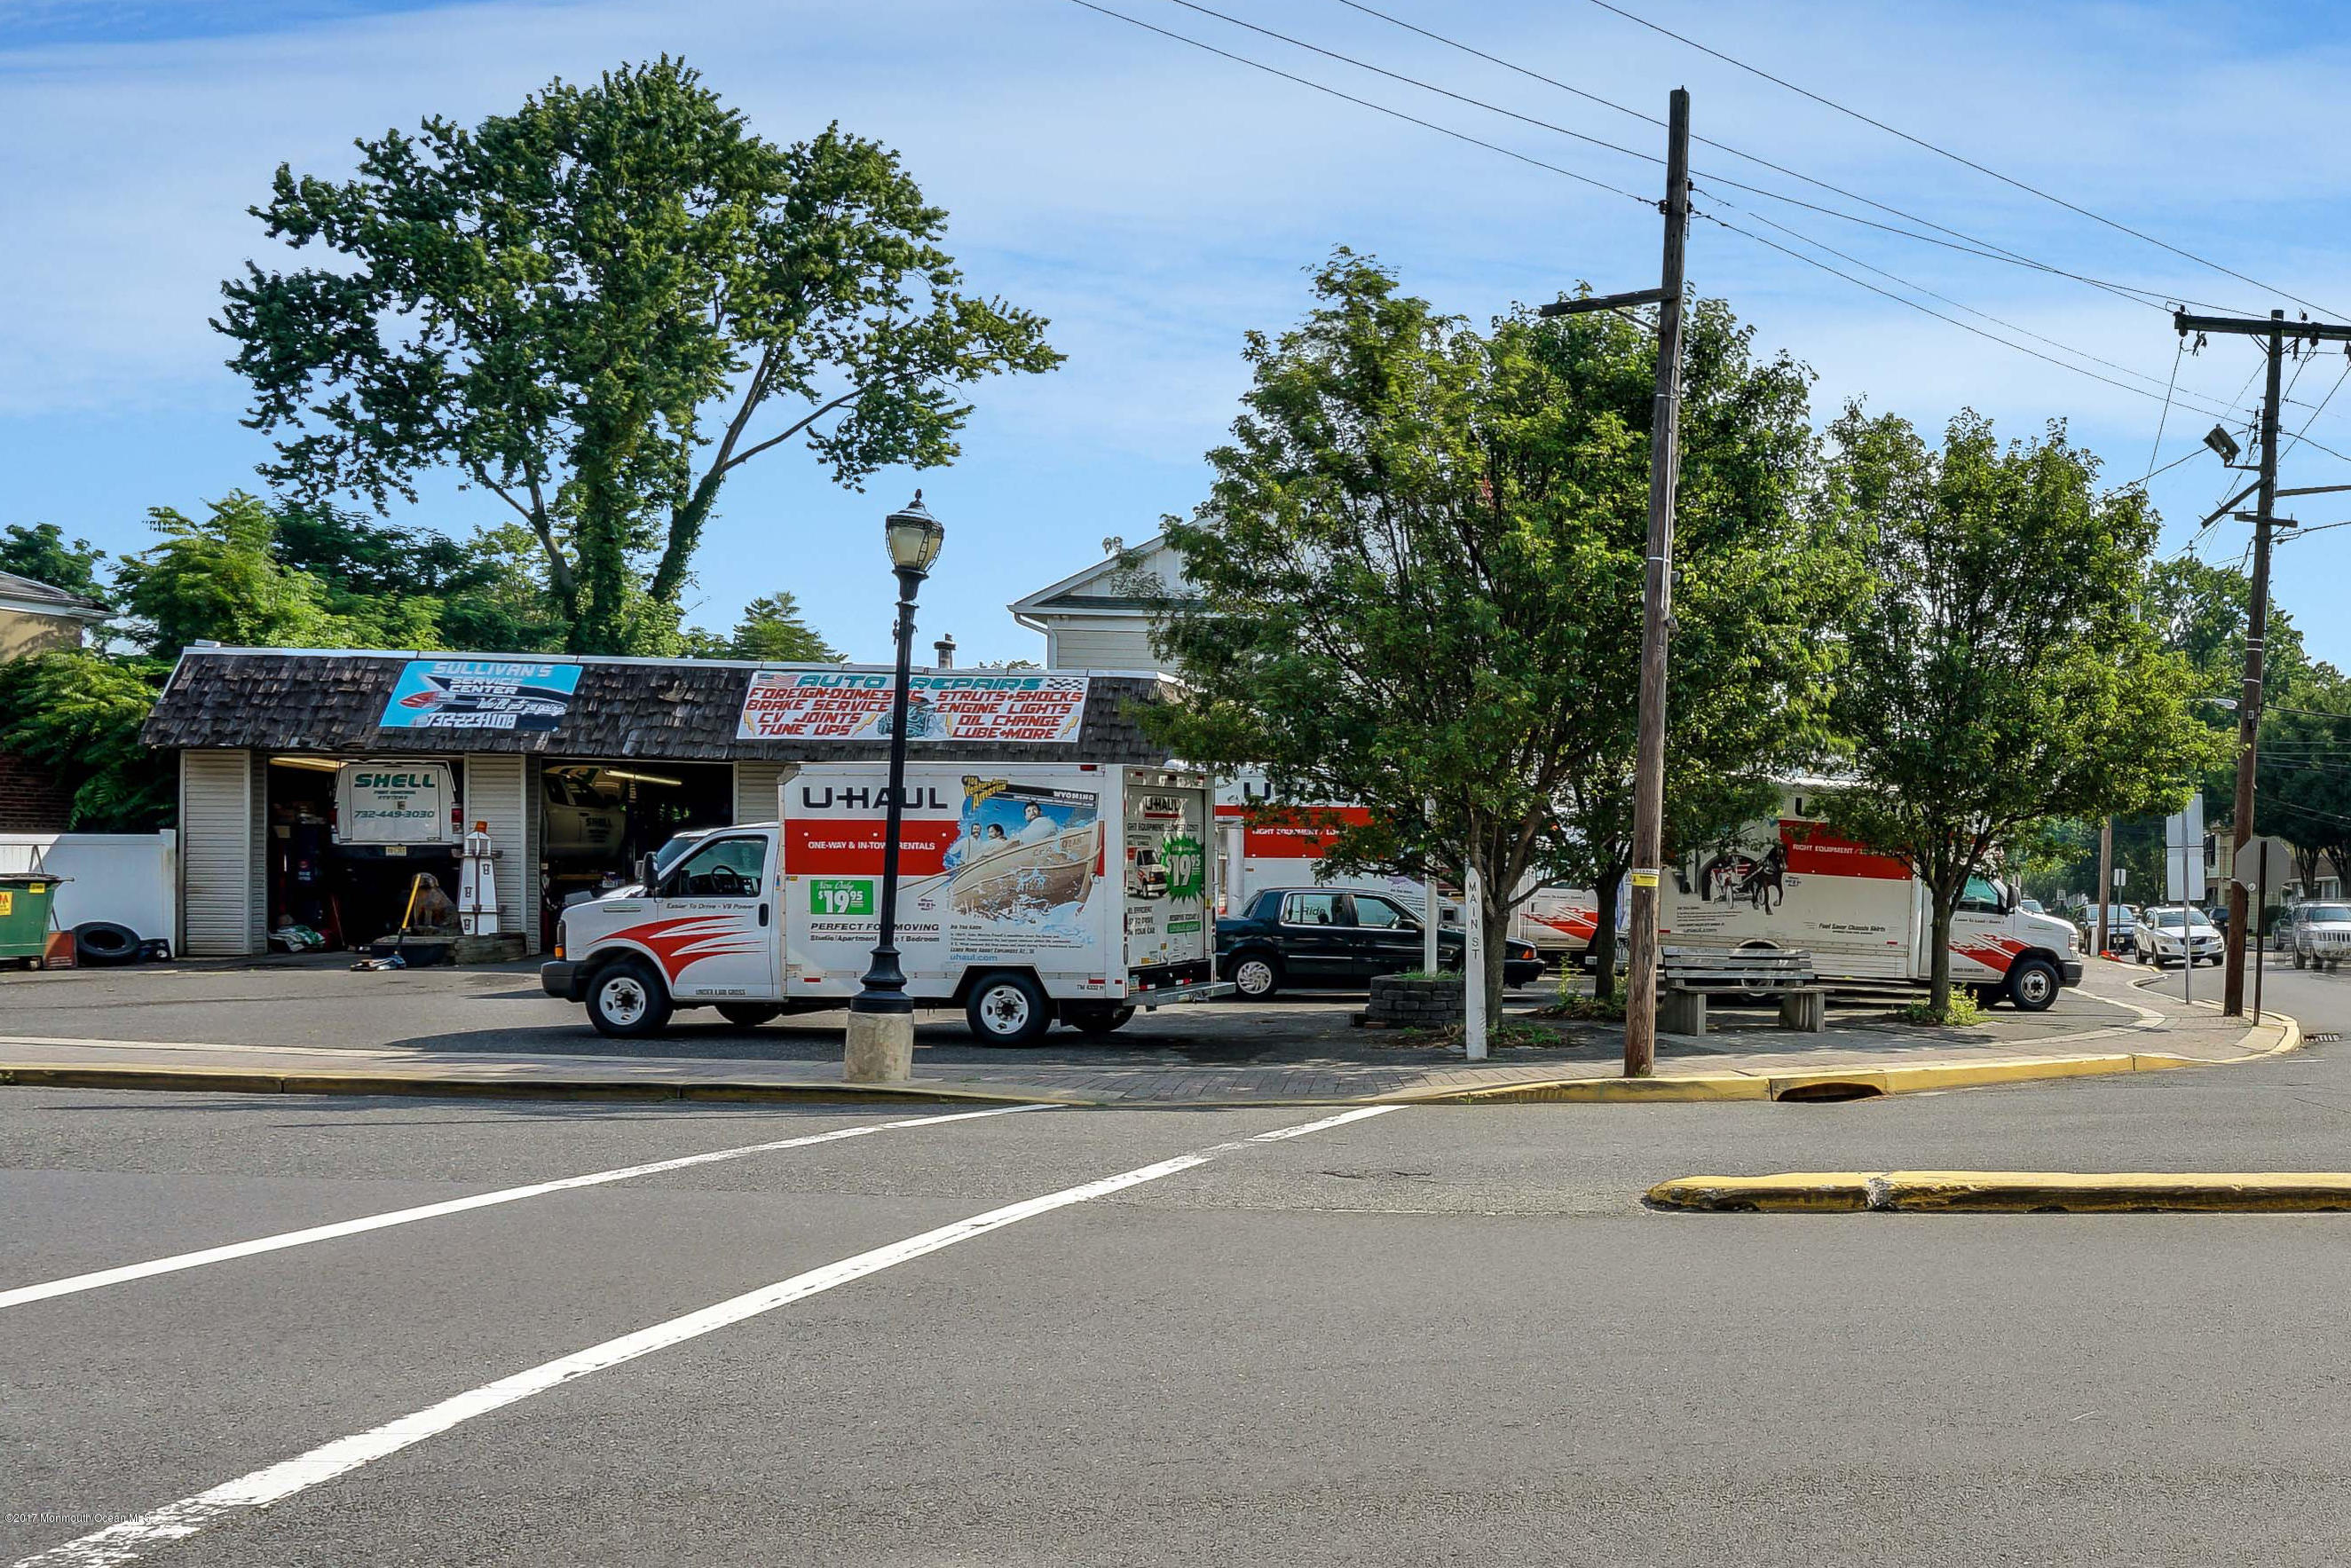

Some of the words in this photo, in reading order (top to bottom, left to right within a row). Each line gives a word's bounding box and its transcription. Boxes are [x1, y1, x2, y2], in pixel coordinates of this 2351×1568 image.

[432, 663, 553, 677] SULLIVAN'S
[450, 676, 524, 685] SERVICE
[796, 674, 887, 688] AUTO
[909, 677, 1044, 690] REPAIRS
[448, 685, 518, 694] CENTER
[746, 699, 808, 711] BRAKE
[812, 699, 893, 712] SERVICE
[935, 703, 1003, 713] ENGINE
[1007, 704, 1074, 714] LIGHTS
[758, 713, 785, 723] CV
[793, 713, 864, 723] JOINTS
[958, 715, 985, 726] OIL
[991, 715, 1065, 726] CHANGE
[759, 724, 809, 735] TUNE
[814, 724, 854, 736] UPS
[354, 773, 436, 788] SHELL
[802, 787, 948, 808] U-HAUL
[898, 841, 935, 850] RENTALS
[1469, 881, 1479, 929] MAIN
[1471, 937, 1479, 959] ST
